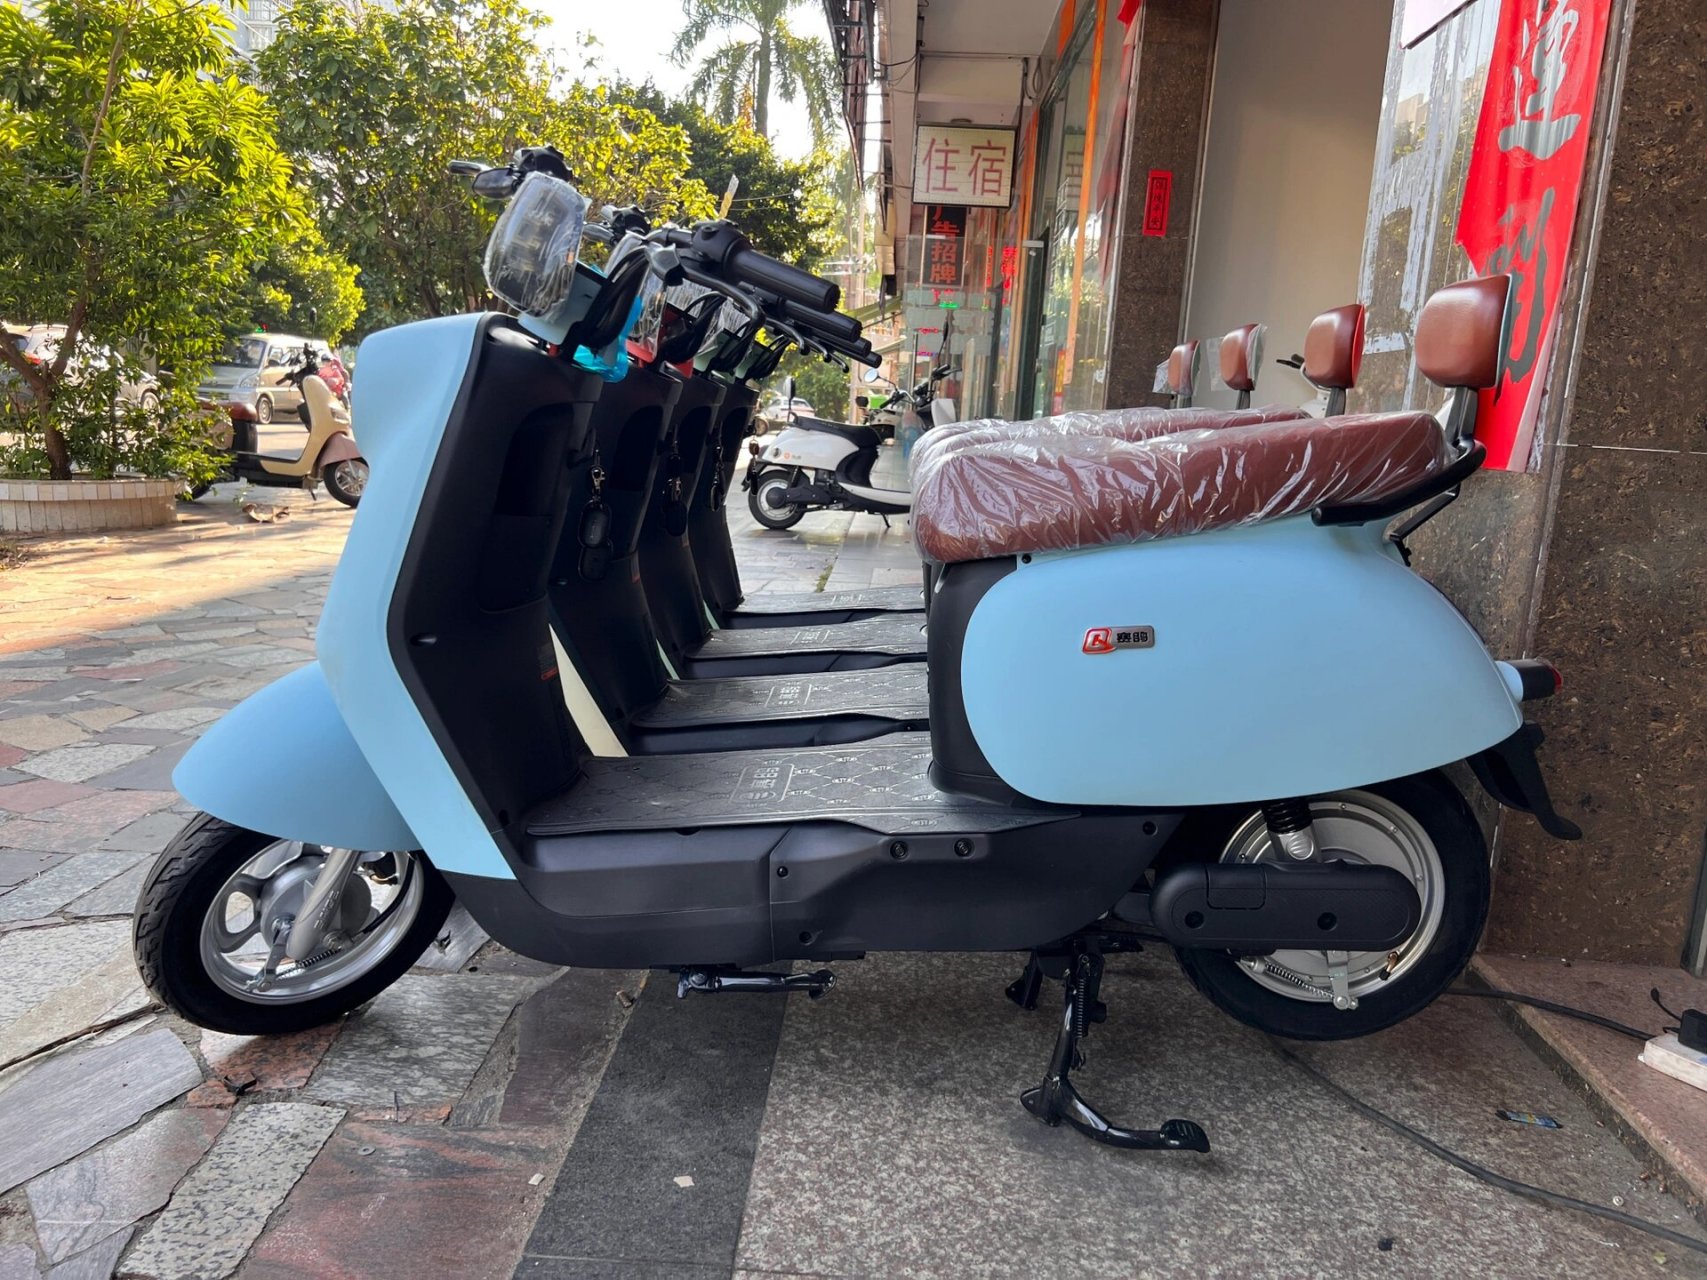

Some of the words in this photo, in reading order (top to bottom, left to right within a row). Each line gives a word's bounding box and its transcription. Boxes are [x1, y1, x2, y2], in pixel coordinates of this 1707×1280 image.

[923, 137, 1007, 196] 住宿
[930, 206, 960, 284] 告招牌
